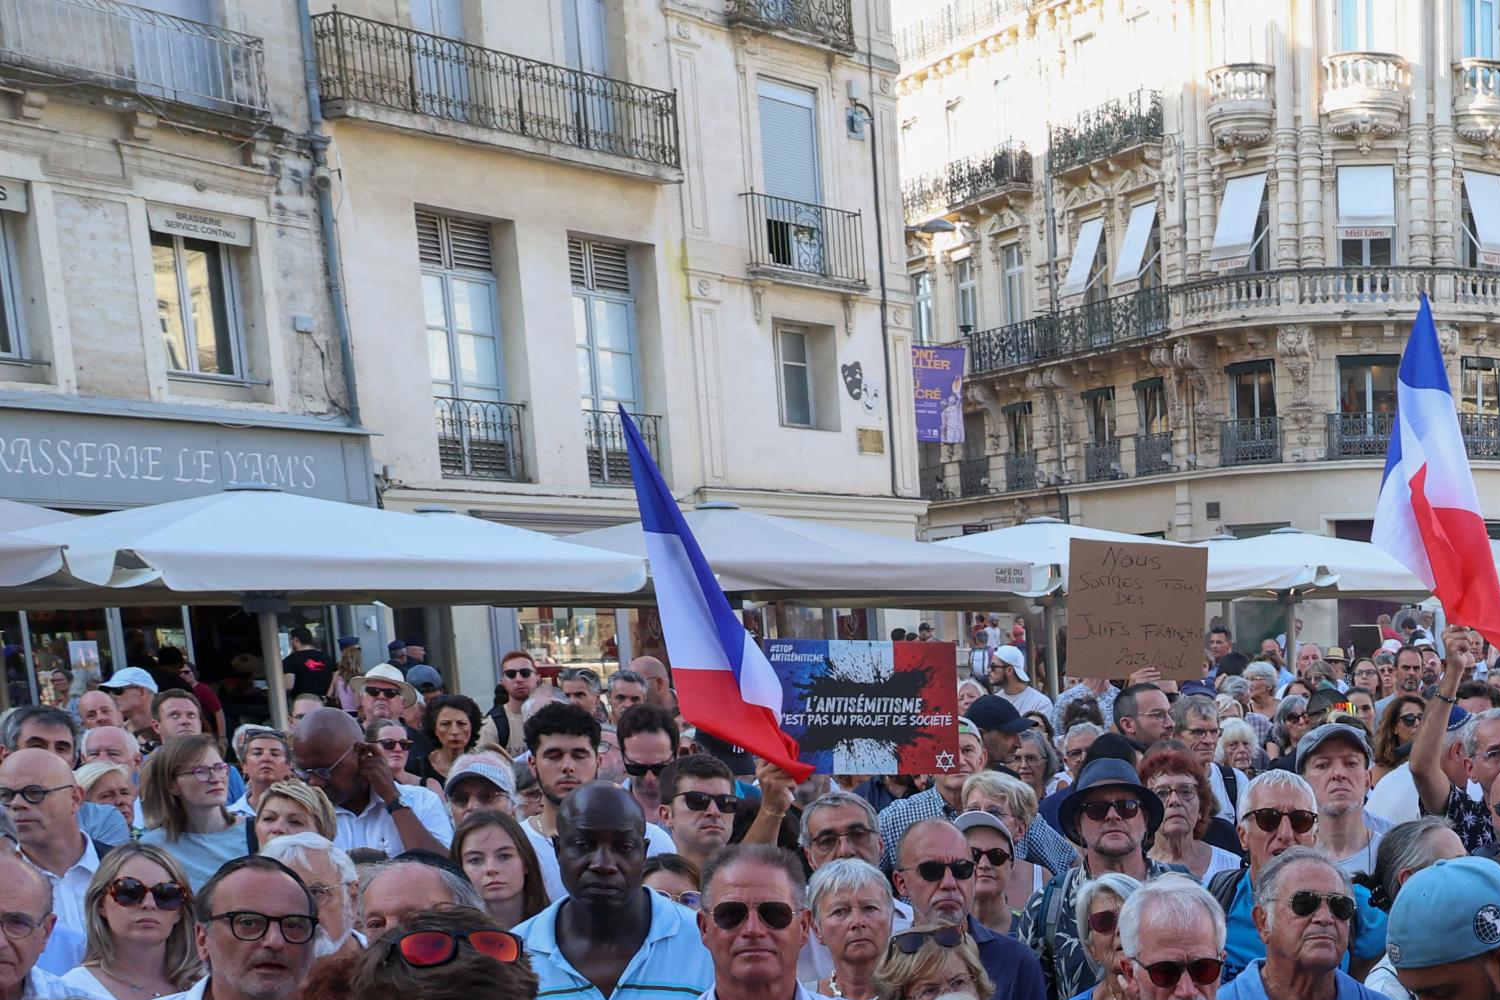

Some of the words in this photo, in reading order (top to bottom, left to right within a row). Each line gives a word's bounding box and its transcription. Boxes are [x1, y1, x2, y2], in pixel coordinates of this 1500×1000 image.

[176, 211, 222, 227] BRASSERIE
[164, 219, 200, 233] SERVICE
[200, 224, 236, 239] CONTINU
[1345, 229, 1363, 238] Midi
[1364, 229, 1385, 237] Libre
[174, 447, 216, 484] LE
[224, 450, 317, 488] YAM'S
[995, 566, 1013, 576] CAFÉ
[1013, 568, 1023, 576] DU
[770, 644, 793, 653] #STOP
[770, 652, 824, 663] ANTISÉMITISME
[805, 693, 923, 714] L'ANTISÉMITISME
[781, 713, 807, 726] 'EST
[807, 713, 829, 726] PAS
[831, 713, 847, 726] UN
[849, 713, 891, 727] PROJET
[893, 714, 907, 726] DE
[909, 712, 953, 726] SOCIÉTÉ
